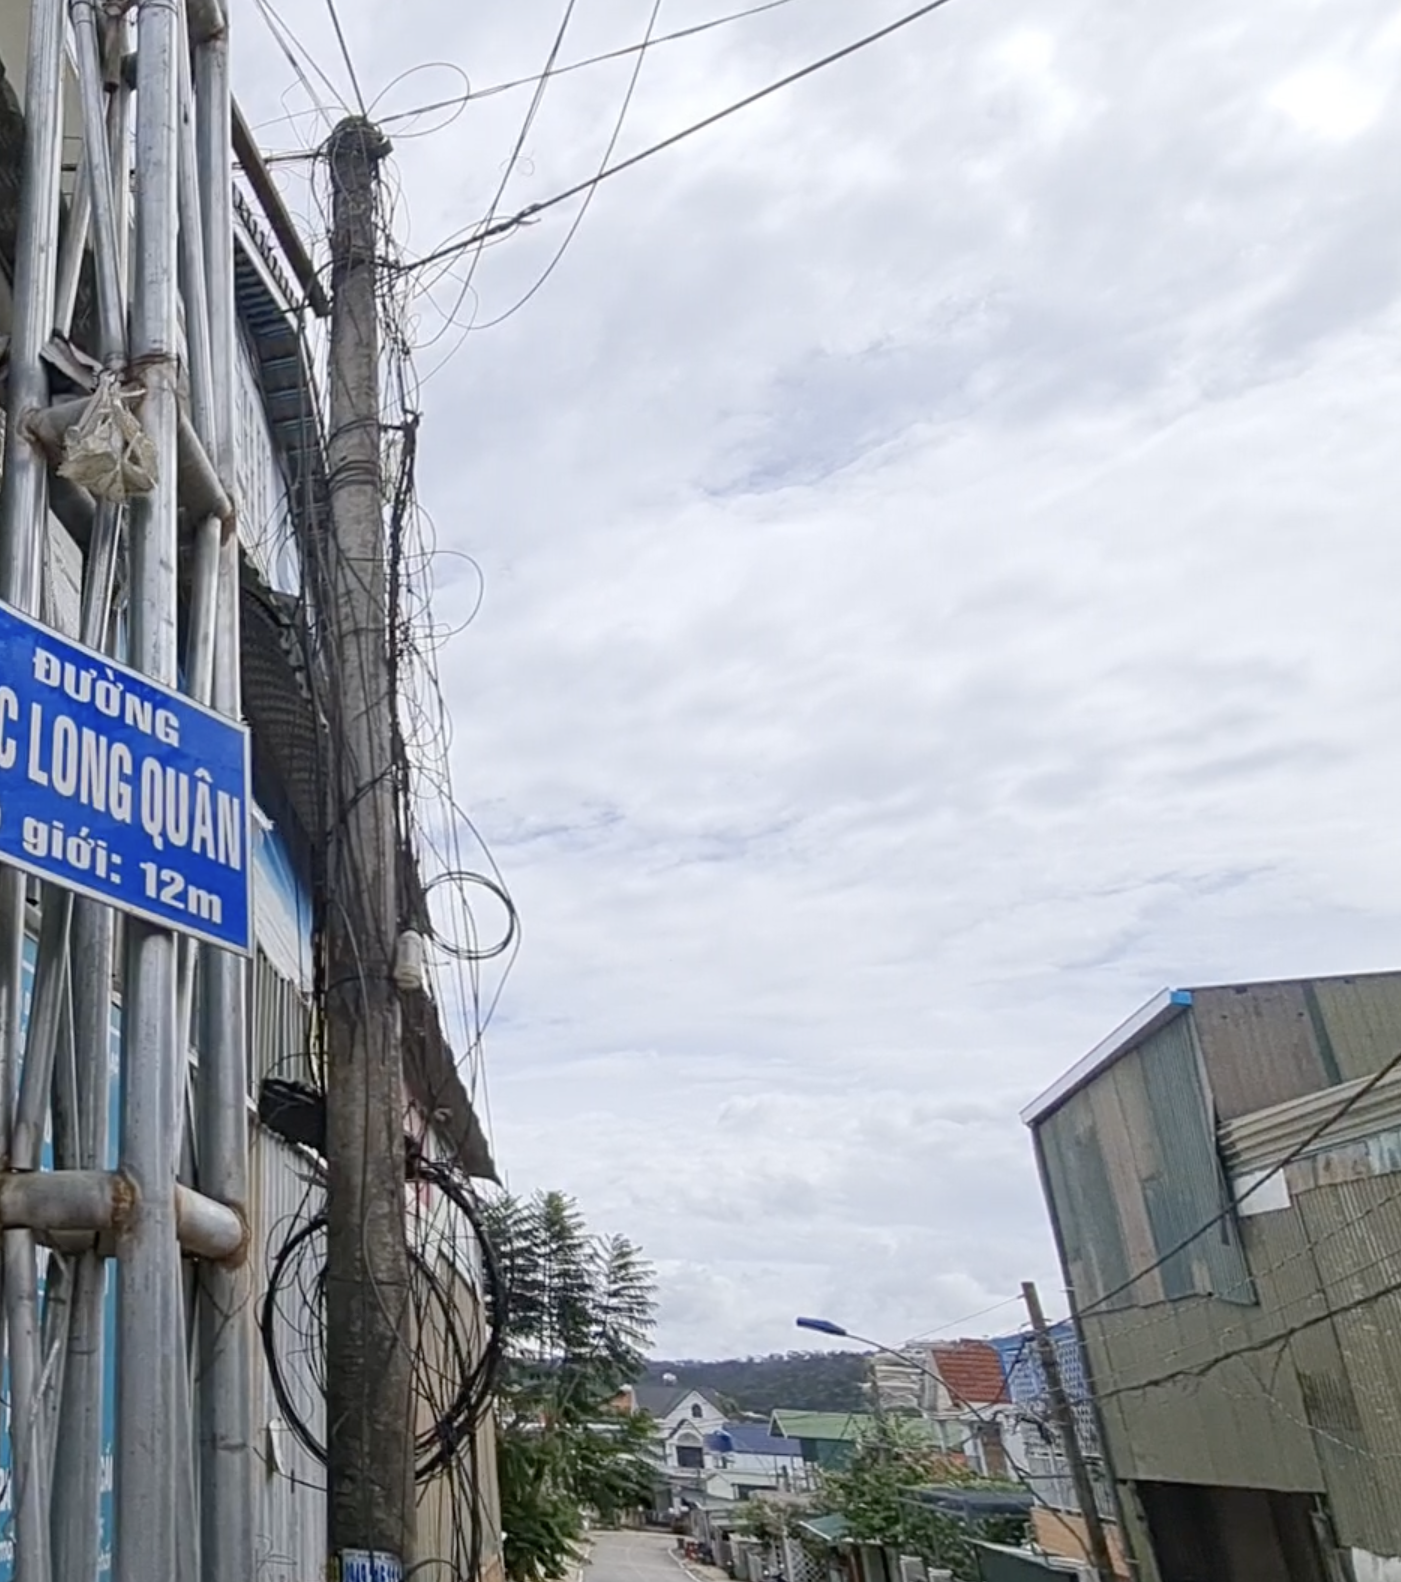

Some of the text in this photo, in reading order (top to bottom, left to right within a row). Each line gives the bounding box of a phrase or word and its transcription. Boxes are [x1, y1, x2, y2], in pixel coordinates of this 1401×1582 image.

[33, 647, 180, 748] ĐƯỜNG
[28, 702, 133, 824] LONG
[141, 756, 242, 871] QUÂN
[22, 816, 122, 884] giới:
[140, 861, 222, 924] 12m
